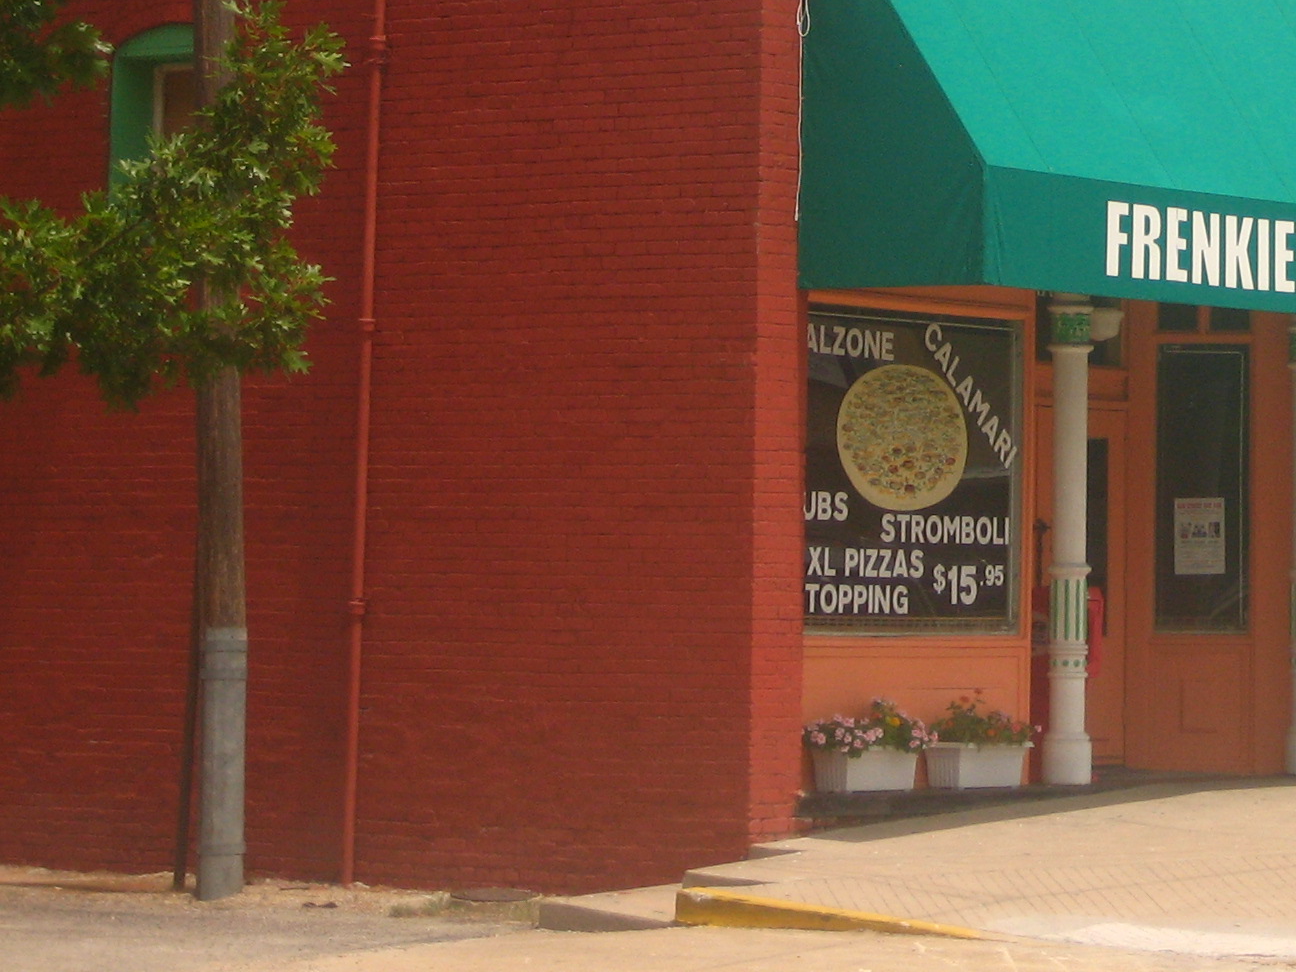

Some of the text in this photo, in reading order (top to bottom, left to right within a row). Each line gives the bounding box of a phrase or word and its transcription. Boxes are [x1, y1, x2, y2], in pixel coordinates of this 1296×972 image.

[807, 323, 895, 361] ALZONE
[924, 322, 1018, 469] CALAMARI
[803, 491, 848, 521] UBS
[880, 513, 1010, 545] STROMBOLI
[807, 546, 925, 579] XL PIZZAS
[805, 584, 909, 615] TOPPING
[933, 563, 1004, 605] $15.95
